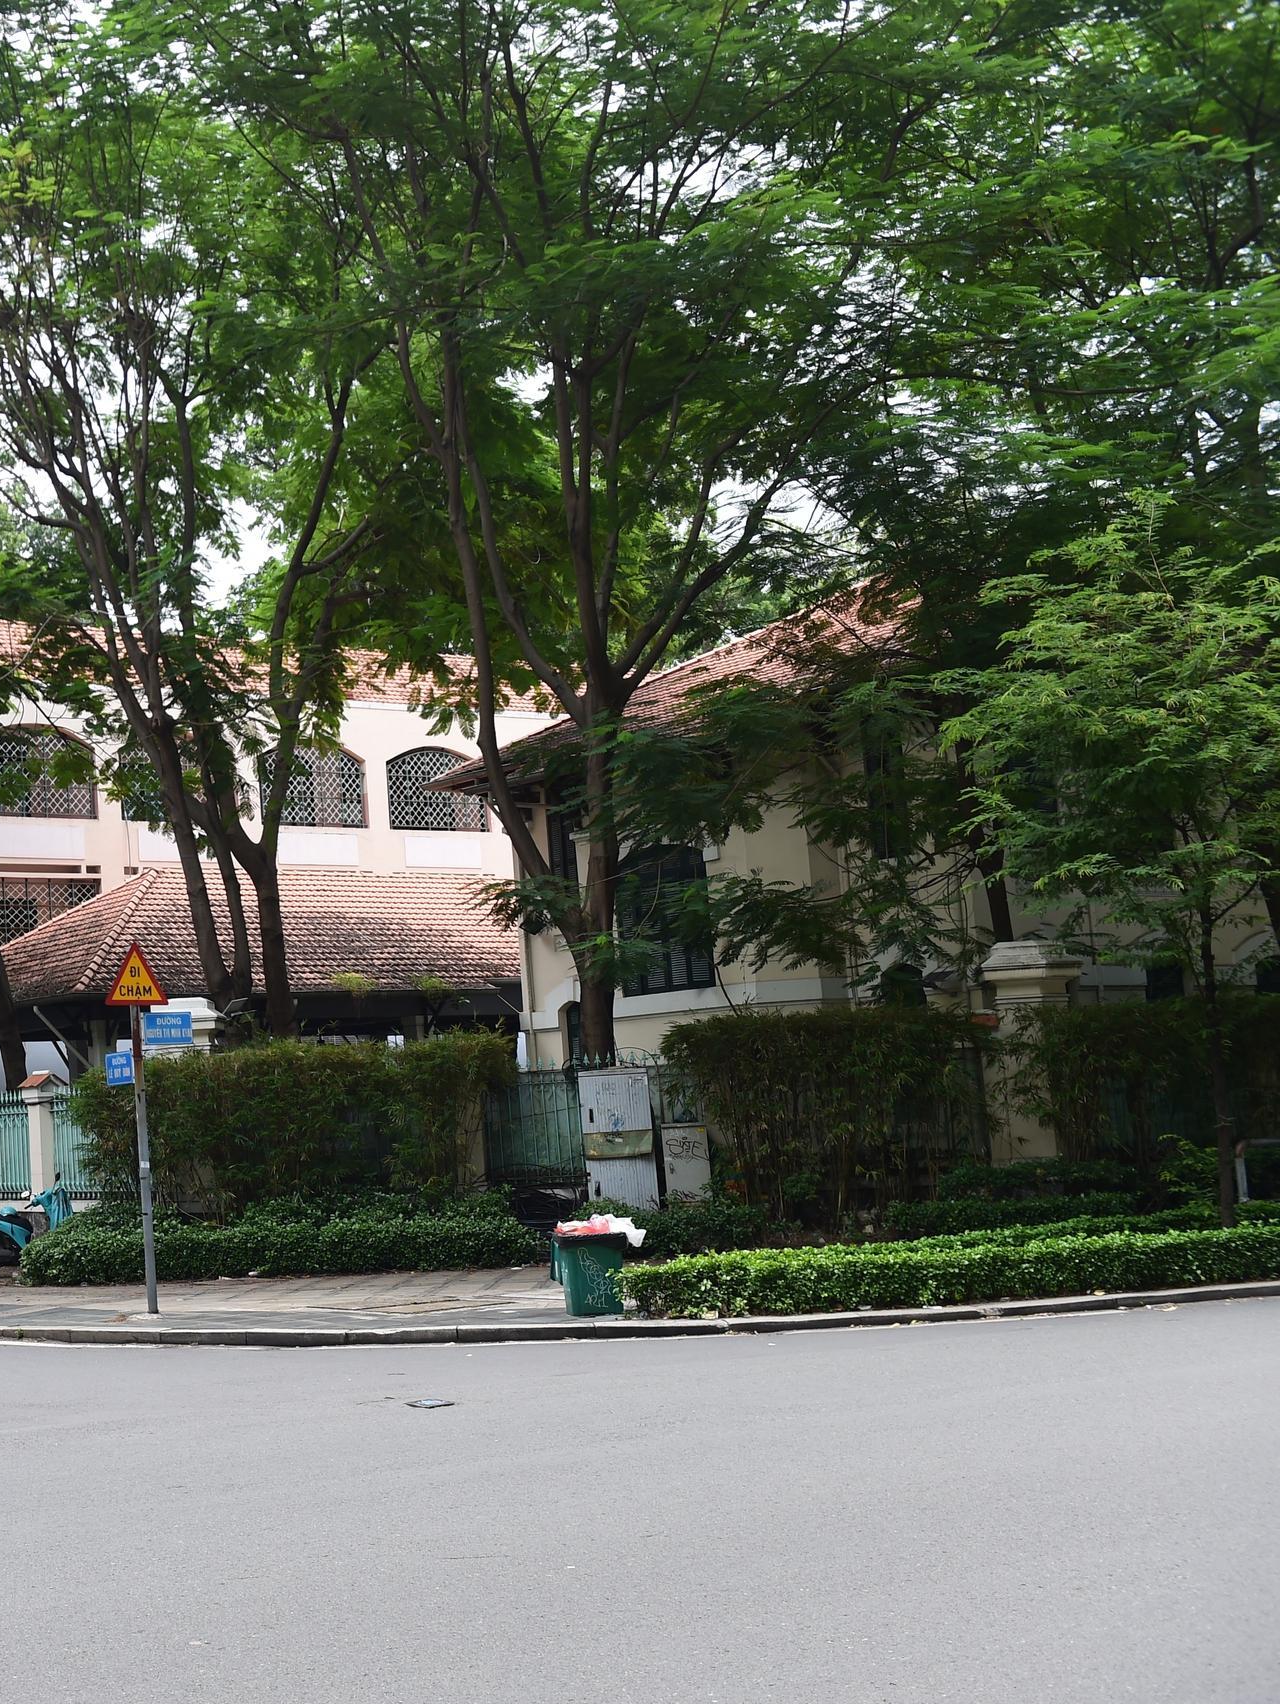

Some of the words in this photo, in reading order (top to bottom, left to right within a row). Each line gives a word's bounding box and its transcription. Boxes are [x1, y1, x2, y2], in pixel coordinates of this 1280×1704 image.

[129, 966, 141, 978] ĐI
[119, 982, 152, 999] CHẬM
[156, 1016, 182, 1025] ĐƯỜNG
